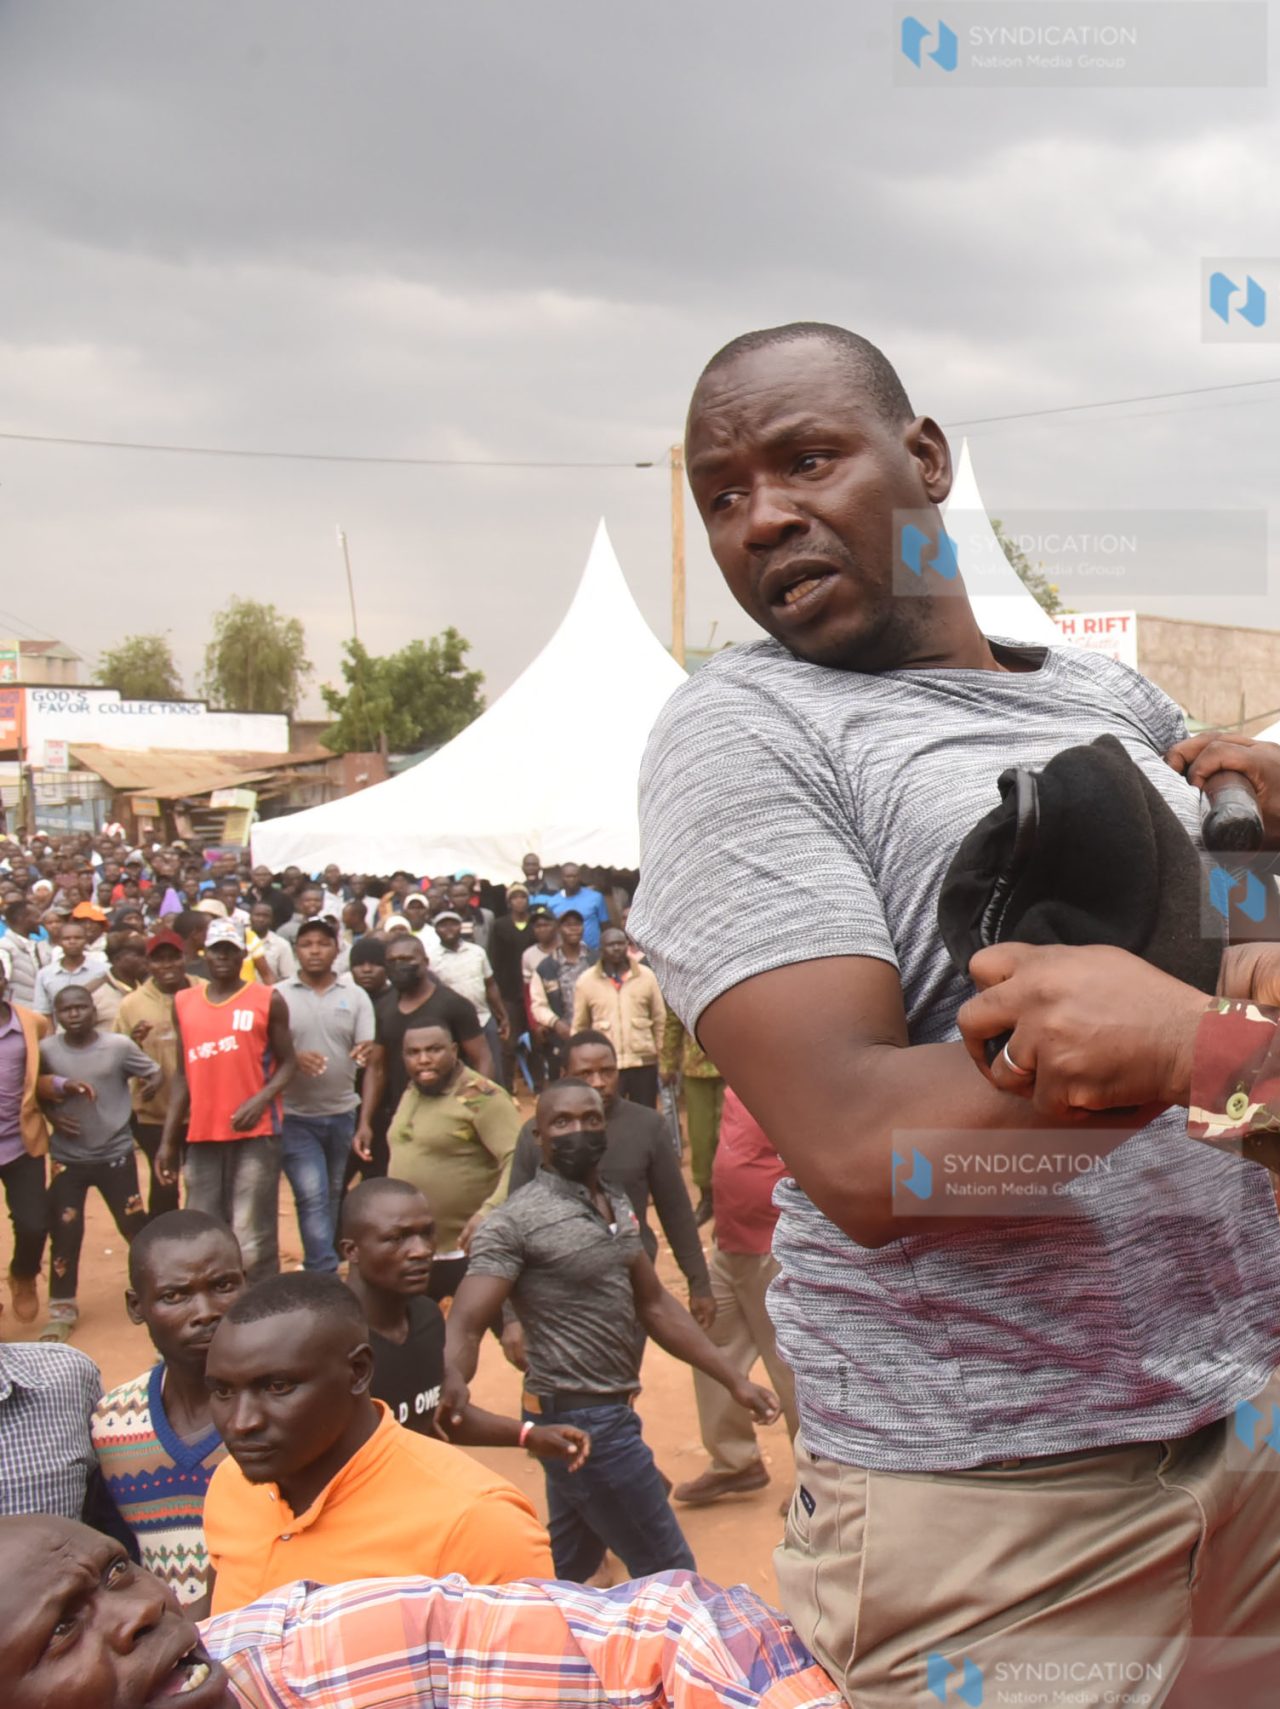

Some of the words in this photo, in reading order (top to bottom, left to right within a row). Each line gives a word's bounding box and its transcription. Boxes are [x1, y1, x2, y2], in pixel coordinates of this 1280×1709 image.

[1083, 616, 1131, 634] RIFT
[32, 690, 88, 702] GOD'S
[38, 703, 91, 714] FAVOR
[98, 703, 201, 715] COLLECTIONS
[232, 1009, 254, 1031] 10
